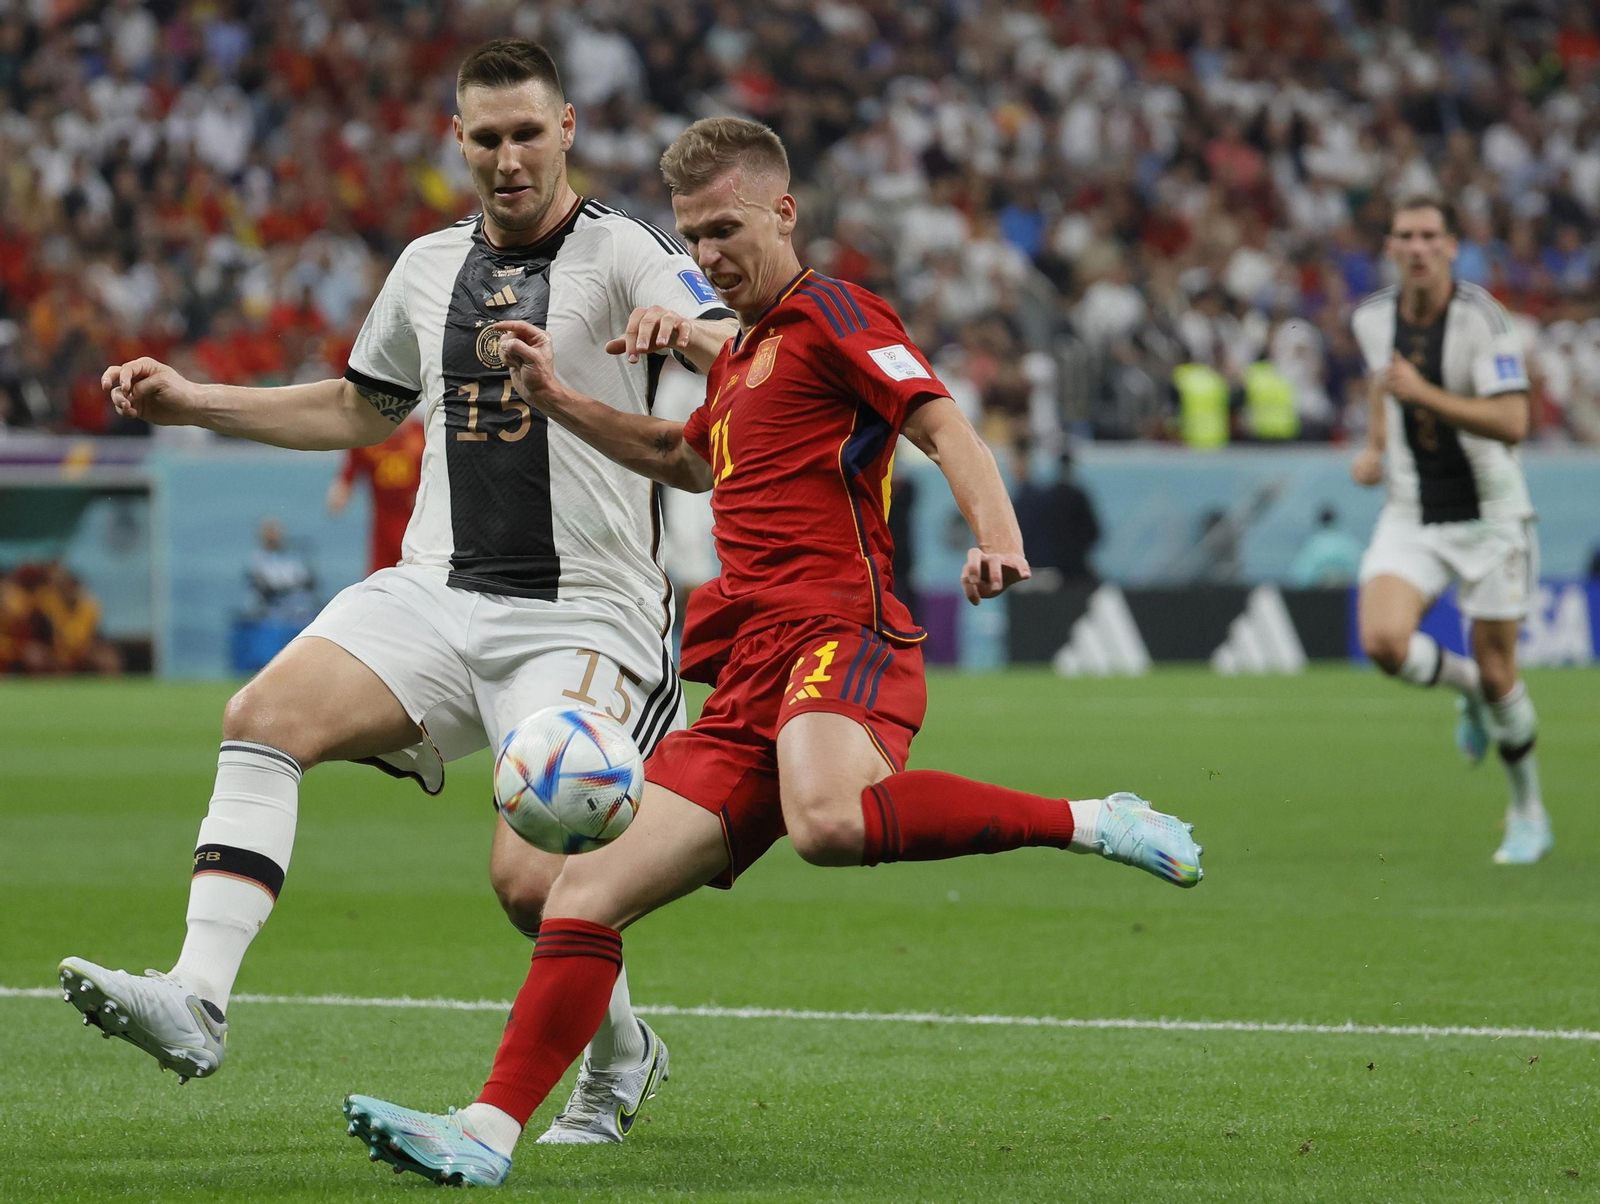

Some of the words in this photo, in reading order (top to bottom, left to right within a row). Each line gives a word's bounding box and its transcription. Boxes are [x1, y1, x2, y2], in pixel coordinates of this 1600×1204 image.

[457, 379, 531, 441] 15
[563, 649, 642, 725] 15
[194, 851, 221, 867] FB
